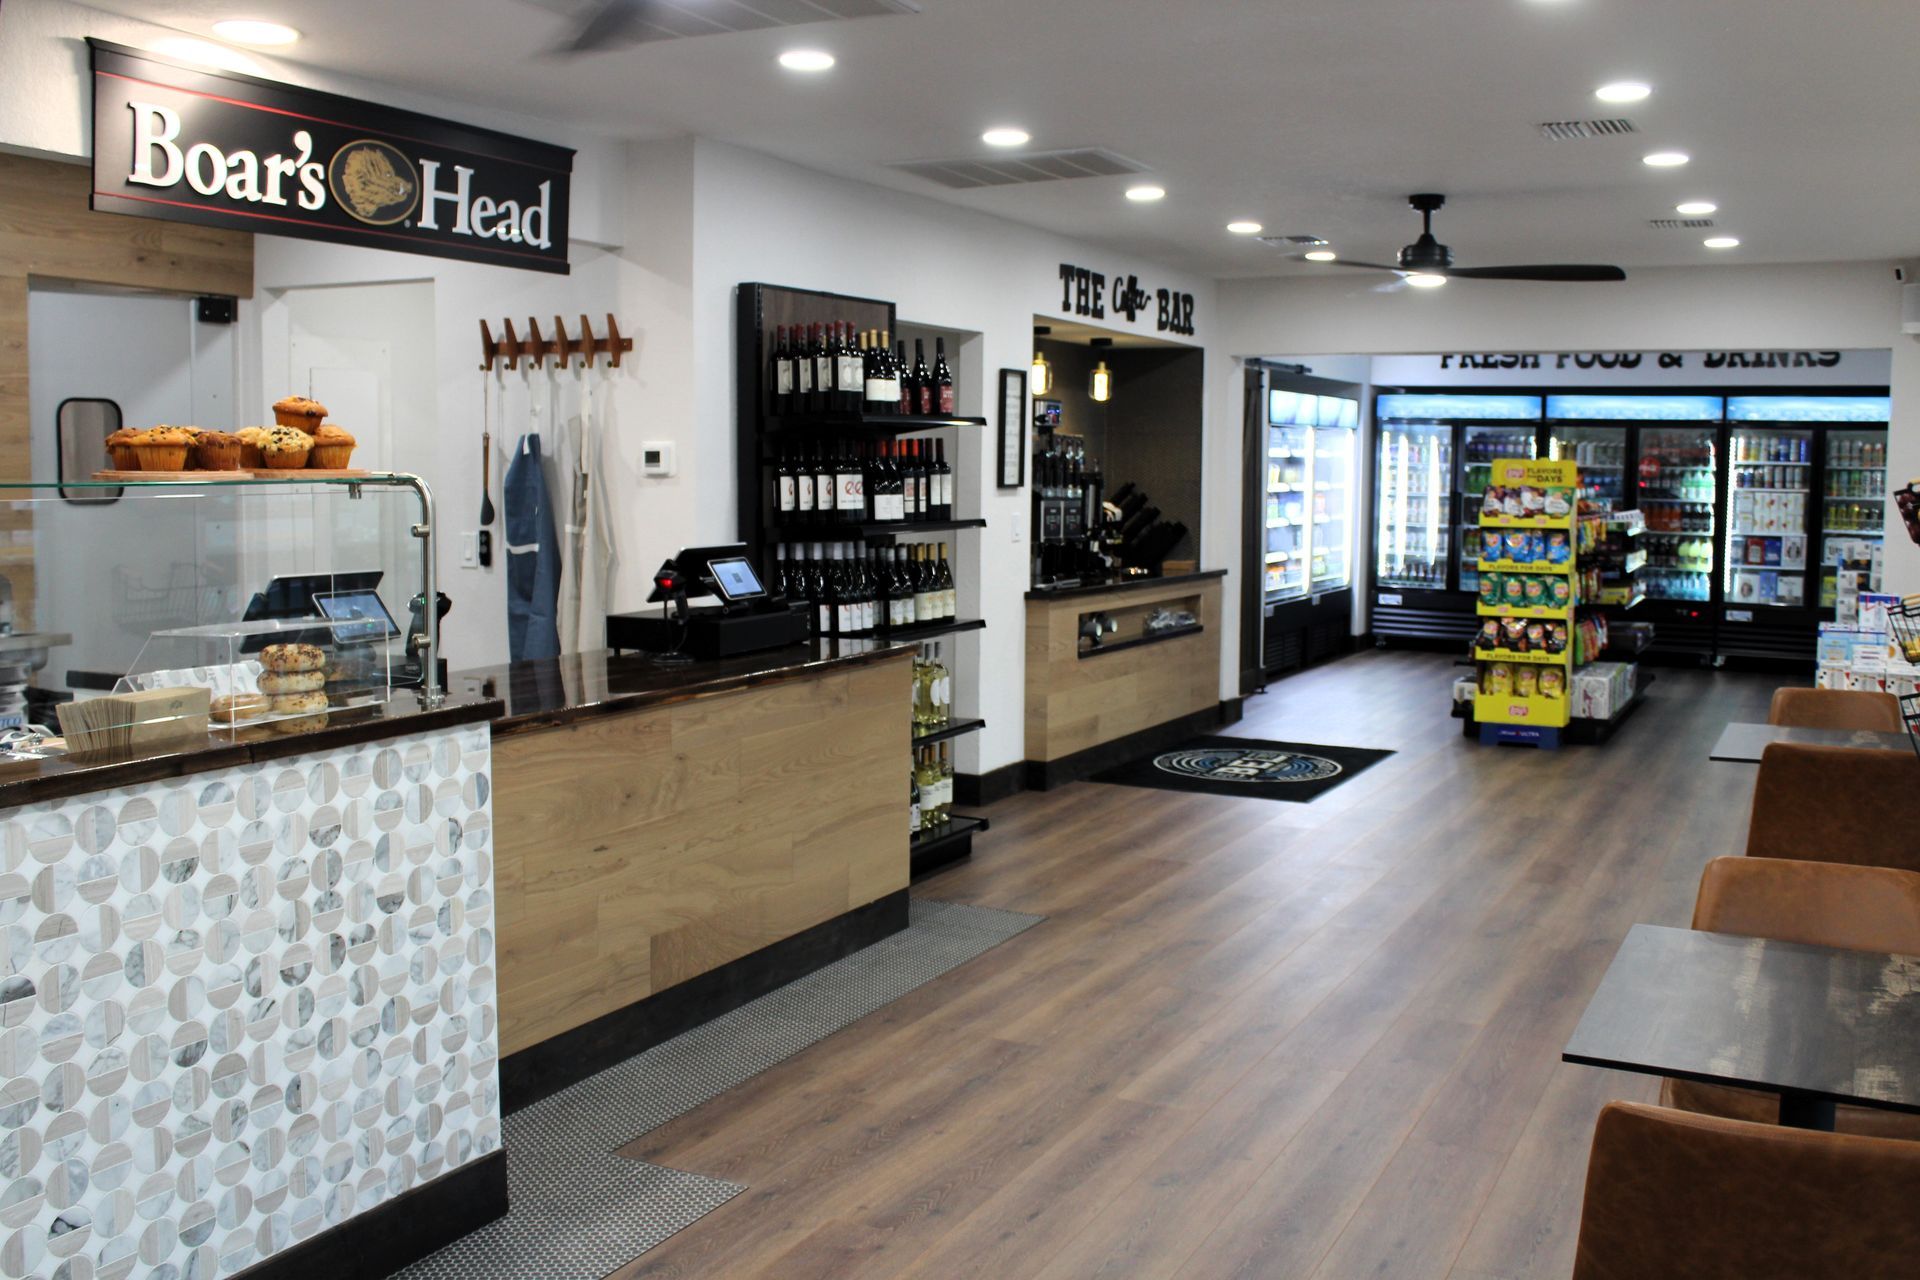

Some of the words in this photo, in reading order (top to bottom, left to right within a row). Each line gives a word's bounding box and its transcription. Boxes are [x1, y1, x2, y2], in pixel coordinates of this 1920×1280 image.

[127, 100, 327, 212] Boar's
[417, 158, 552, 250] Head
[1059, 263, 1105, 319] THE
[1156, 288, 1194, 336] BAR
